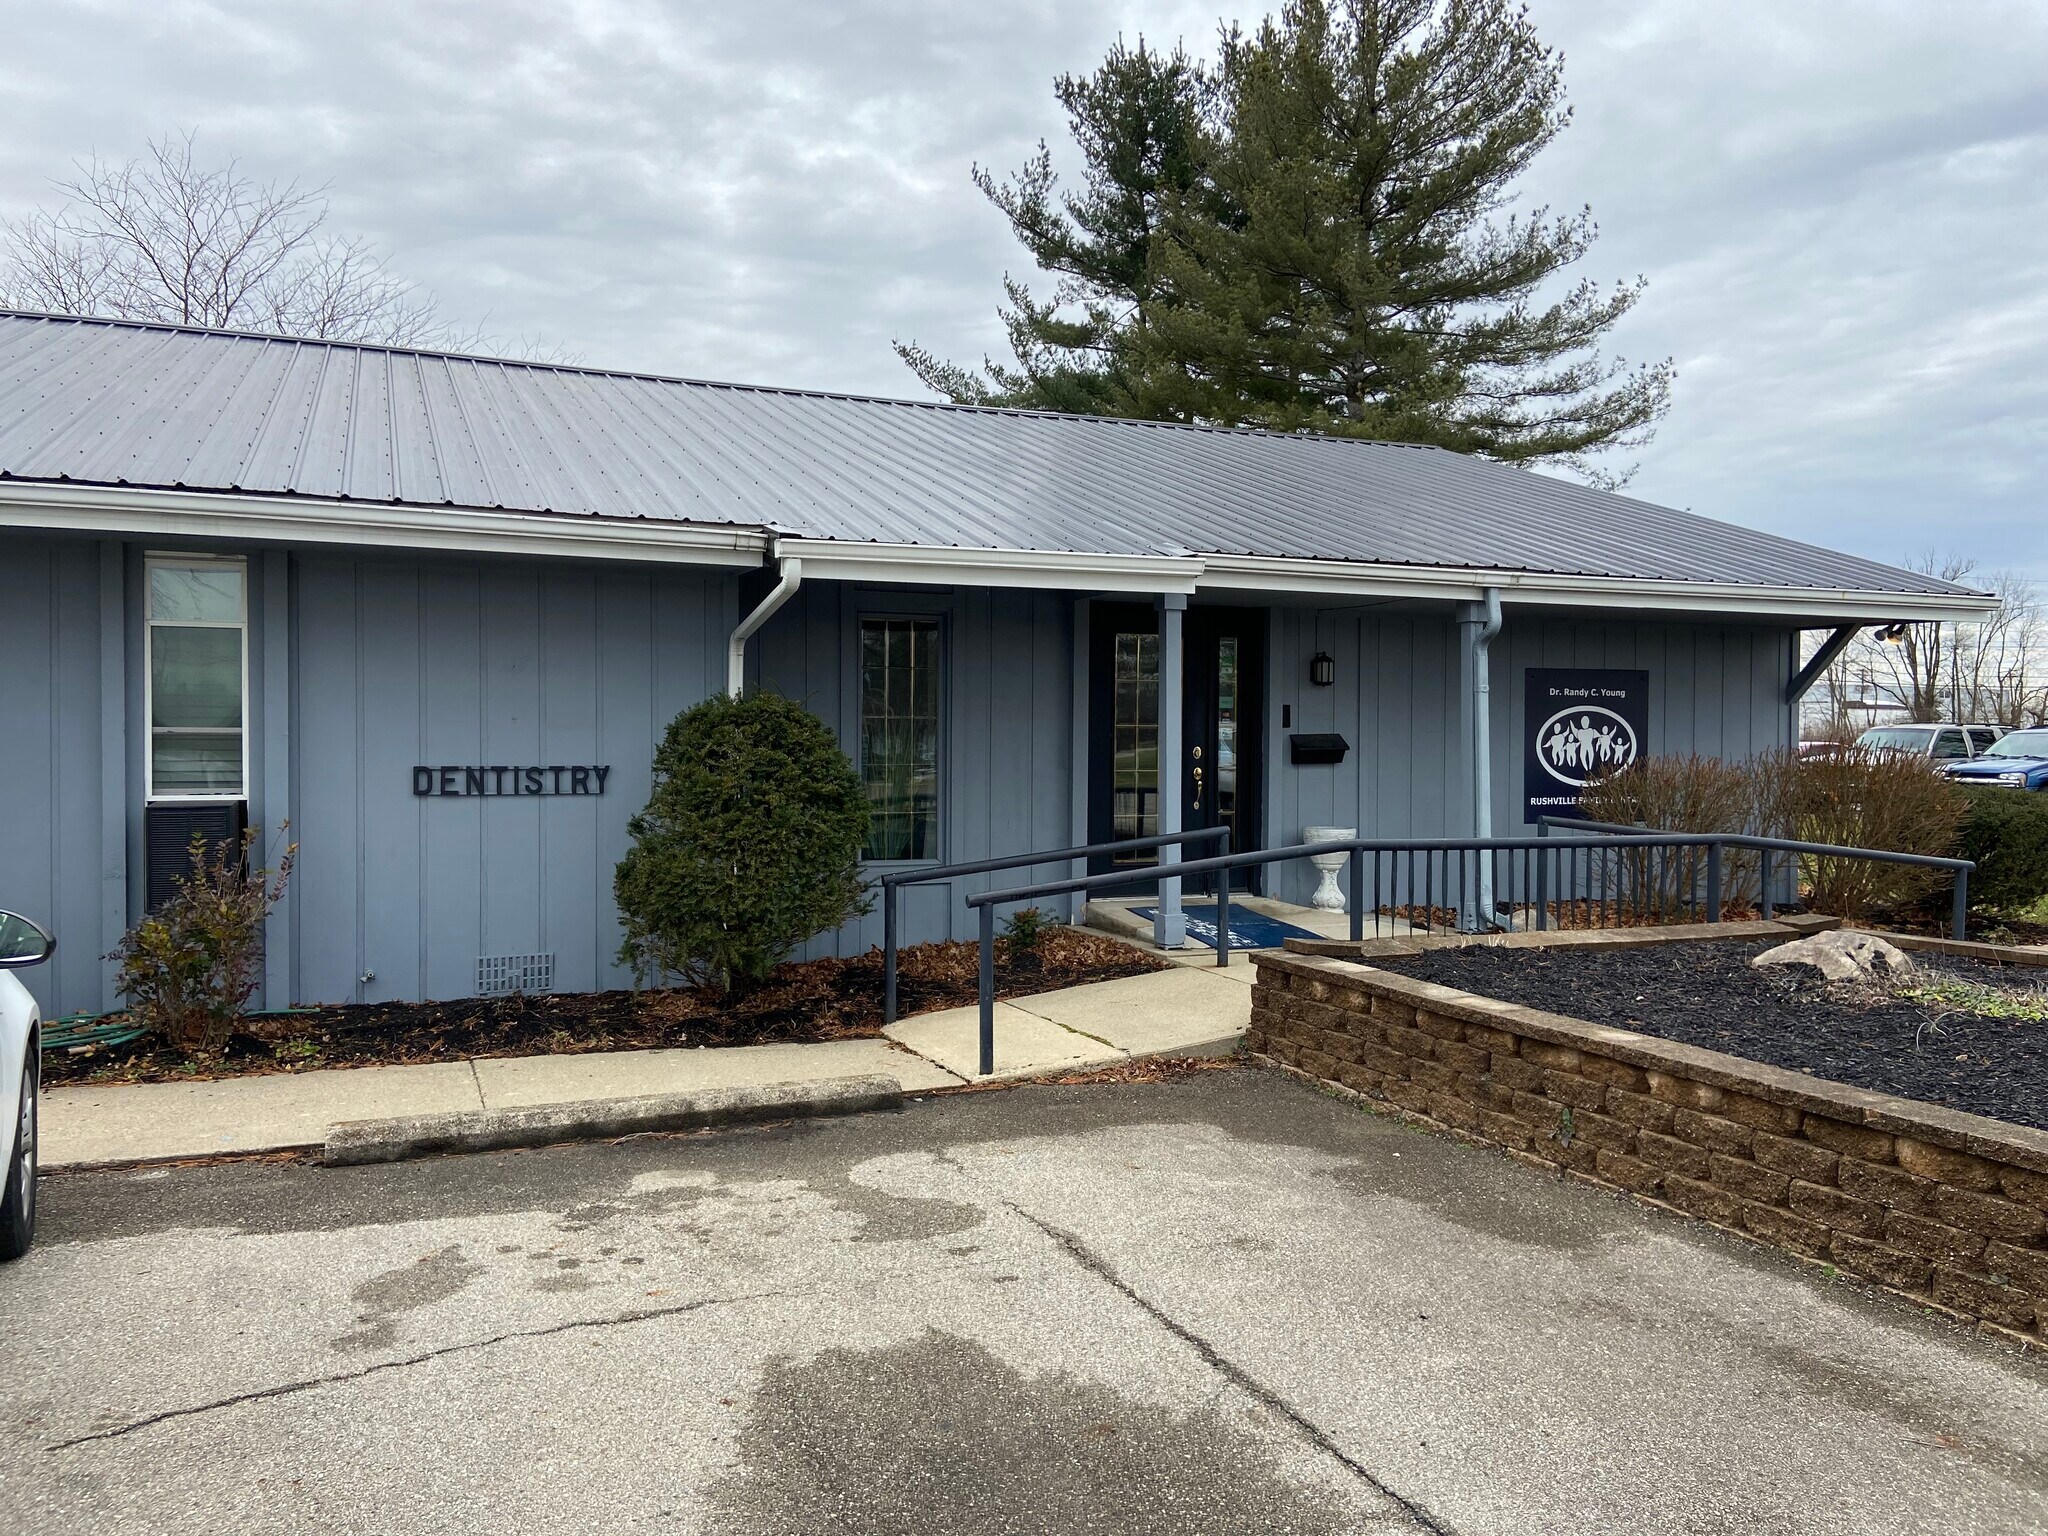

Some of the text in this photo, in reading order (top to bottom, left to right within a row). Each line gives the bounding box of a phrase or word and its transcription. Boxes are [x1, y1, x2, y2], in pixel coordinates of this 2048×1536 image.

[1549, 688, 1626, 699] Dr. Randy C. Young
[413, 765, 610, 796] DENTISTRY
[1530, 797, 1577, 806] RUSHVILLE
